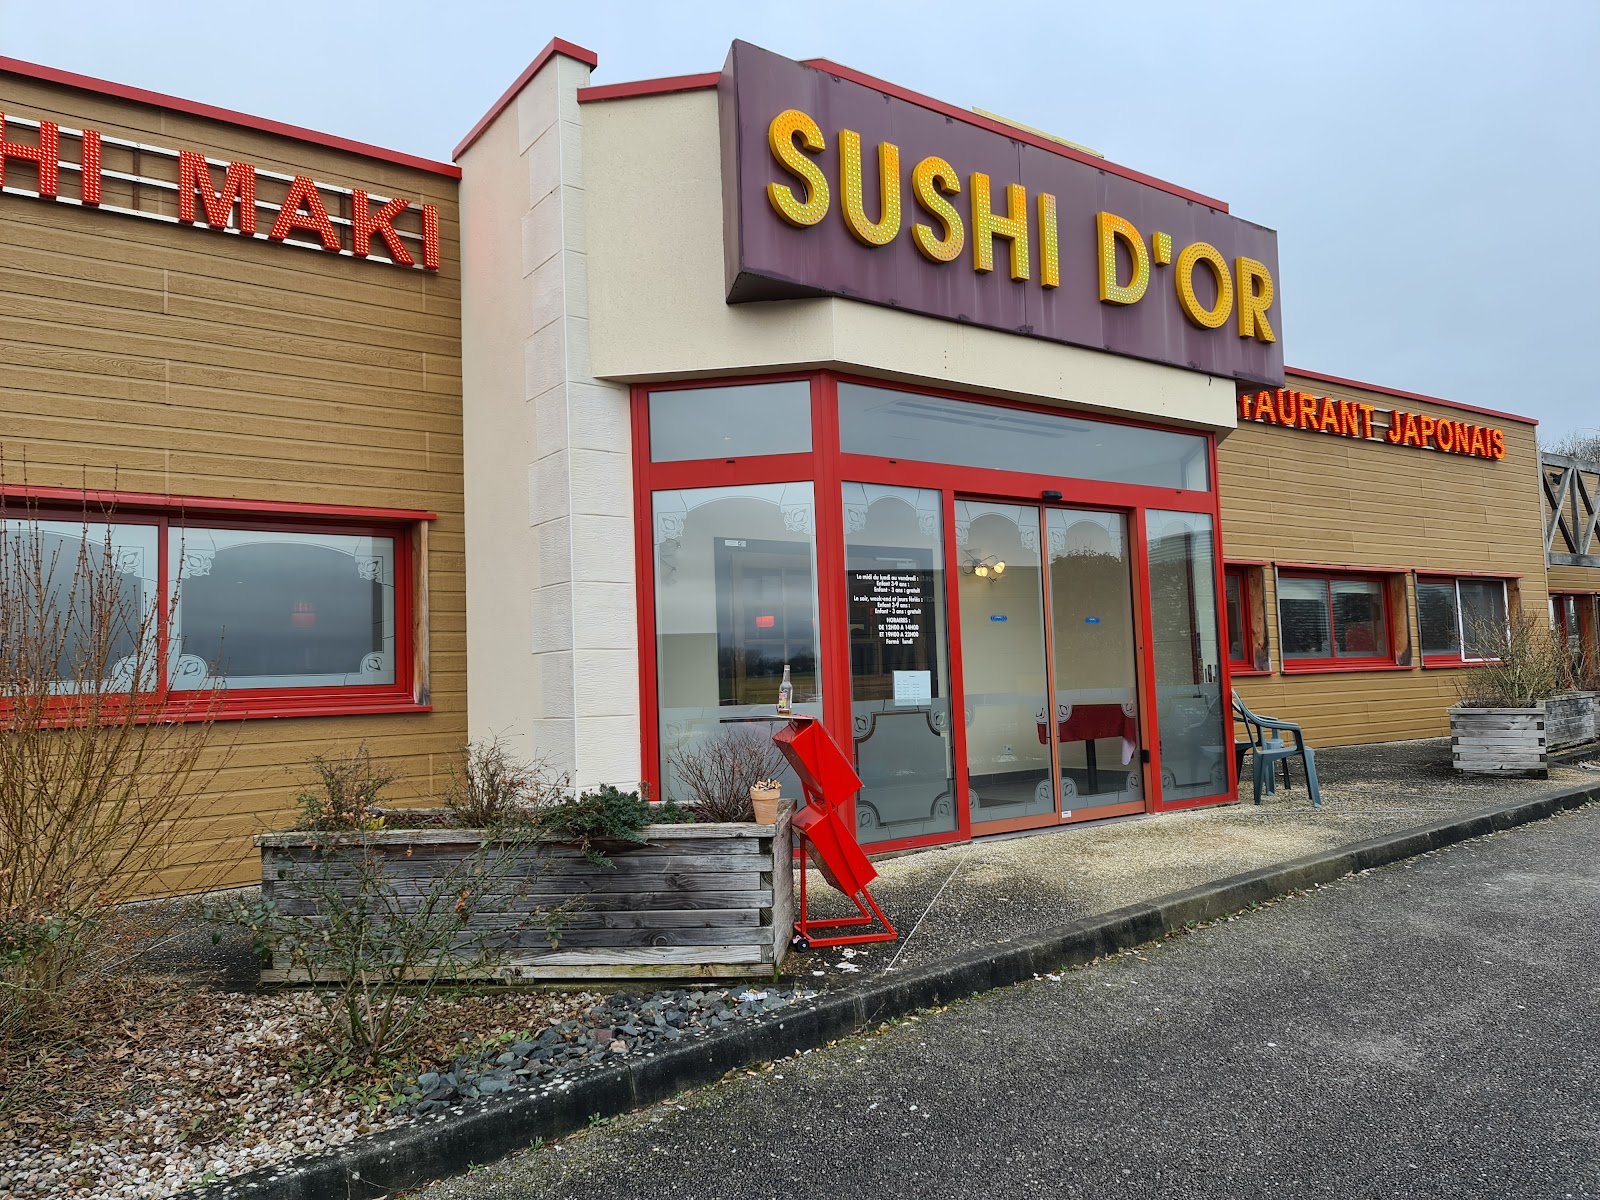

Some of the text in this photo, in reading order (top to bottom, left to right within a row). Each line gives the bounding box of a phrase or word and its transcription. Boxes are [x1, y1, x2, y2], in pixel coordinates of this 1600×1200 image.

[179, 150, 440, 271] MAKI
[767, 109, 1276, 344] SUSHI D'OR
[1386, 409, 1506, 460] JAPONAIS
